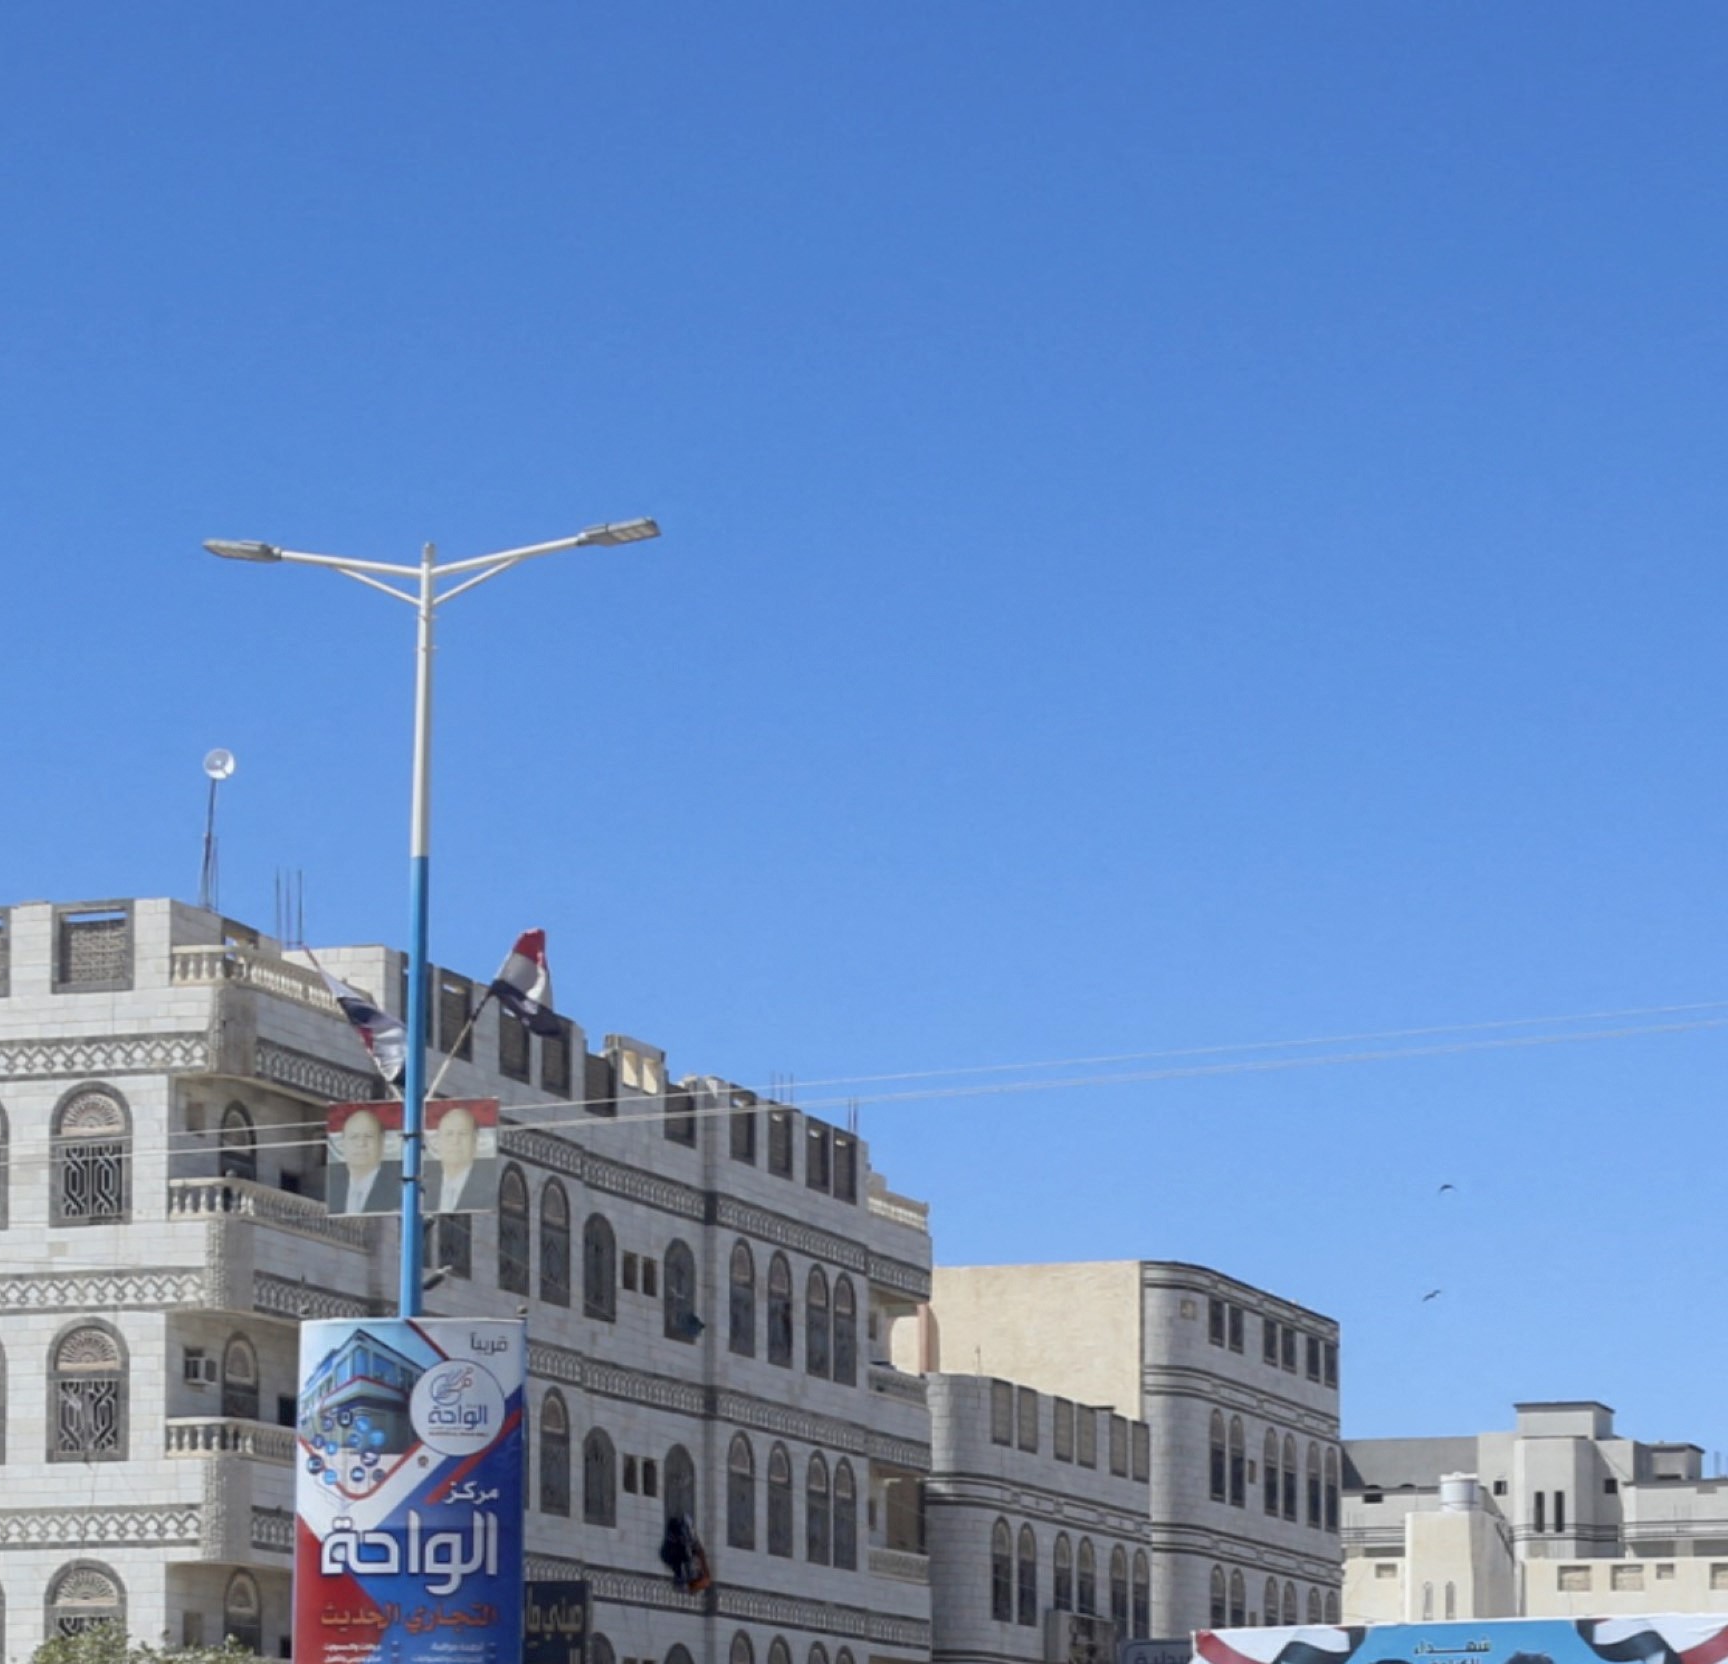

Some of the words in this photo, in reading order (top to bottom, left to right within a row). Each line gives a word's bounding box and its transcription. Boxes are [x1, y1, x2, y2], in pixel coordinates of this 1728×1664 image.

[428, 1404, 488, 1431] الواحة
[444, 1481, 500, 1505] مركز
[320, 1510, 500, 1596] الواحة
[321, 1604, 400, 1632] الحديث
[405, 1603, 498, 1635] التجاري
